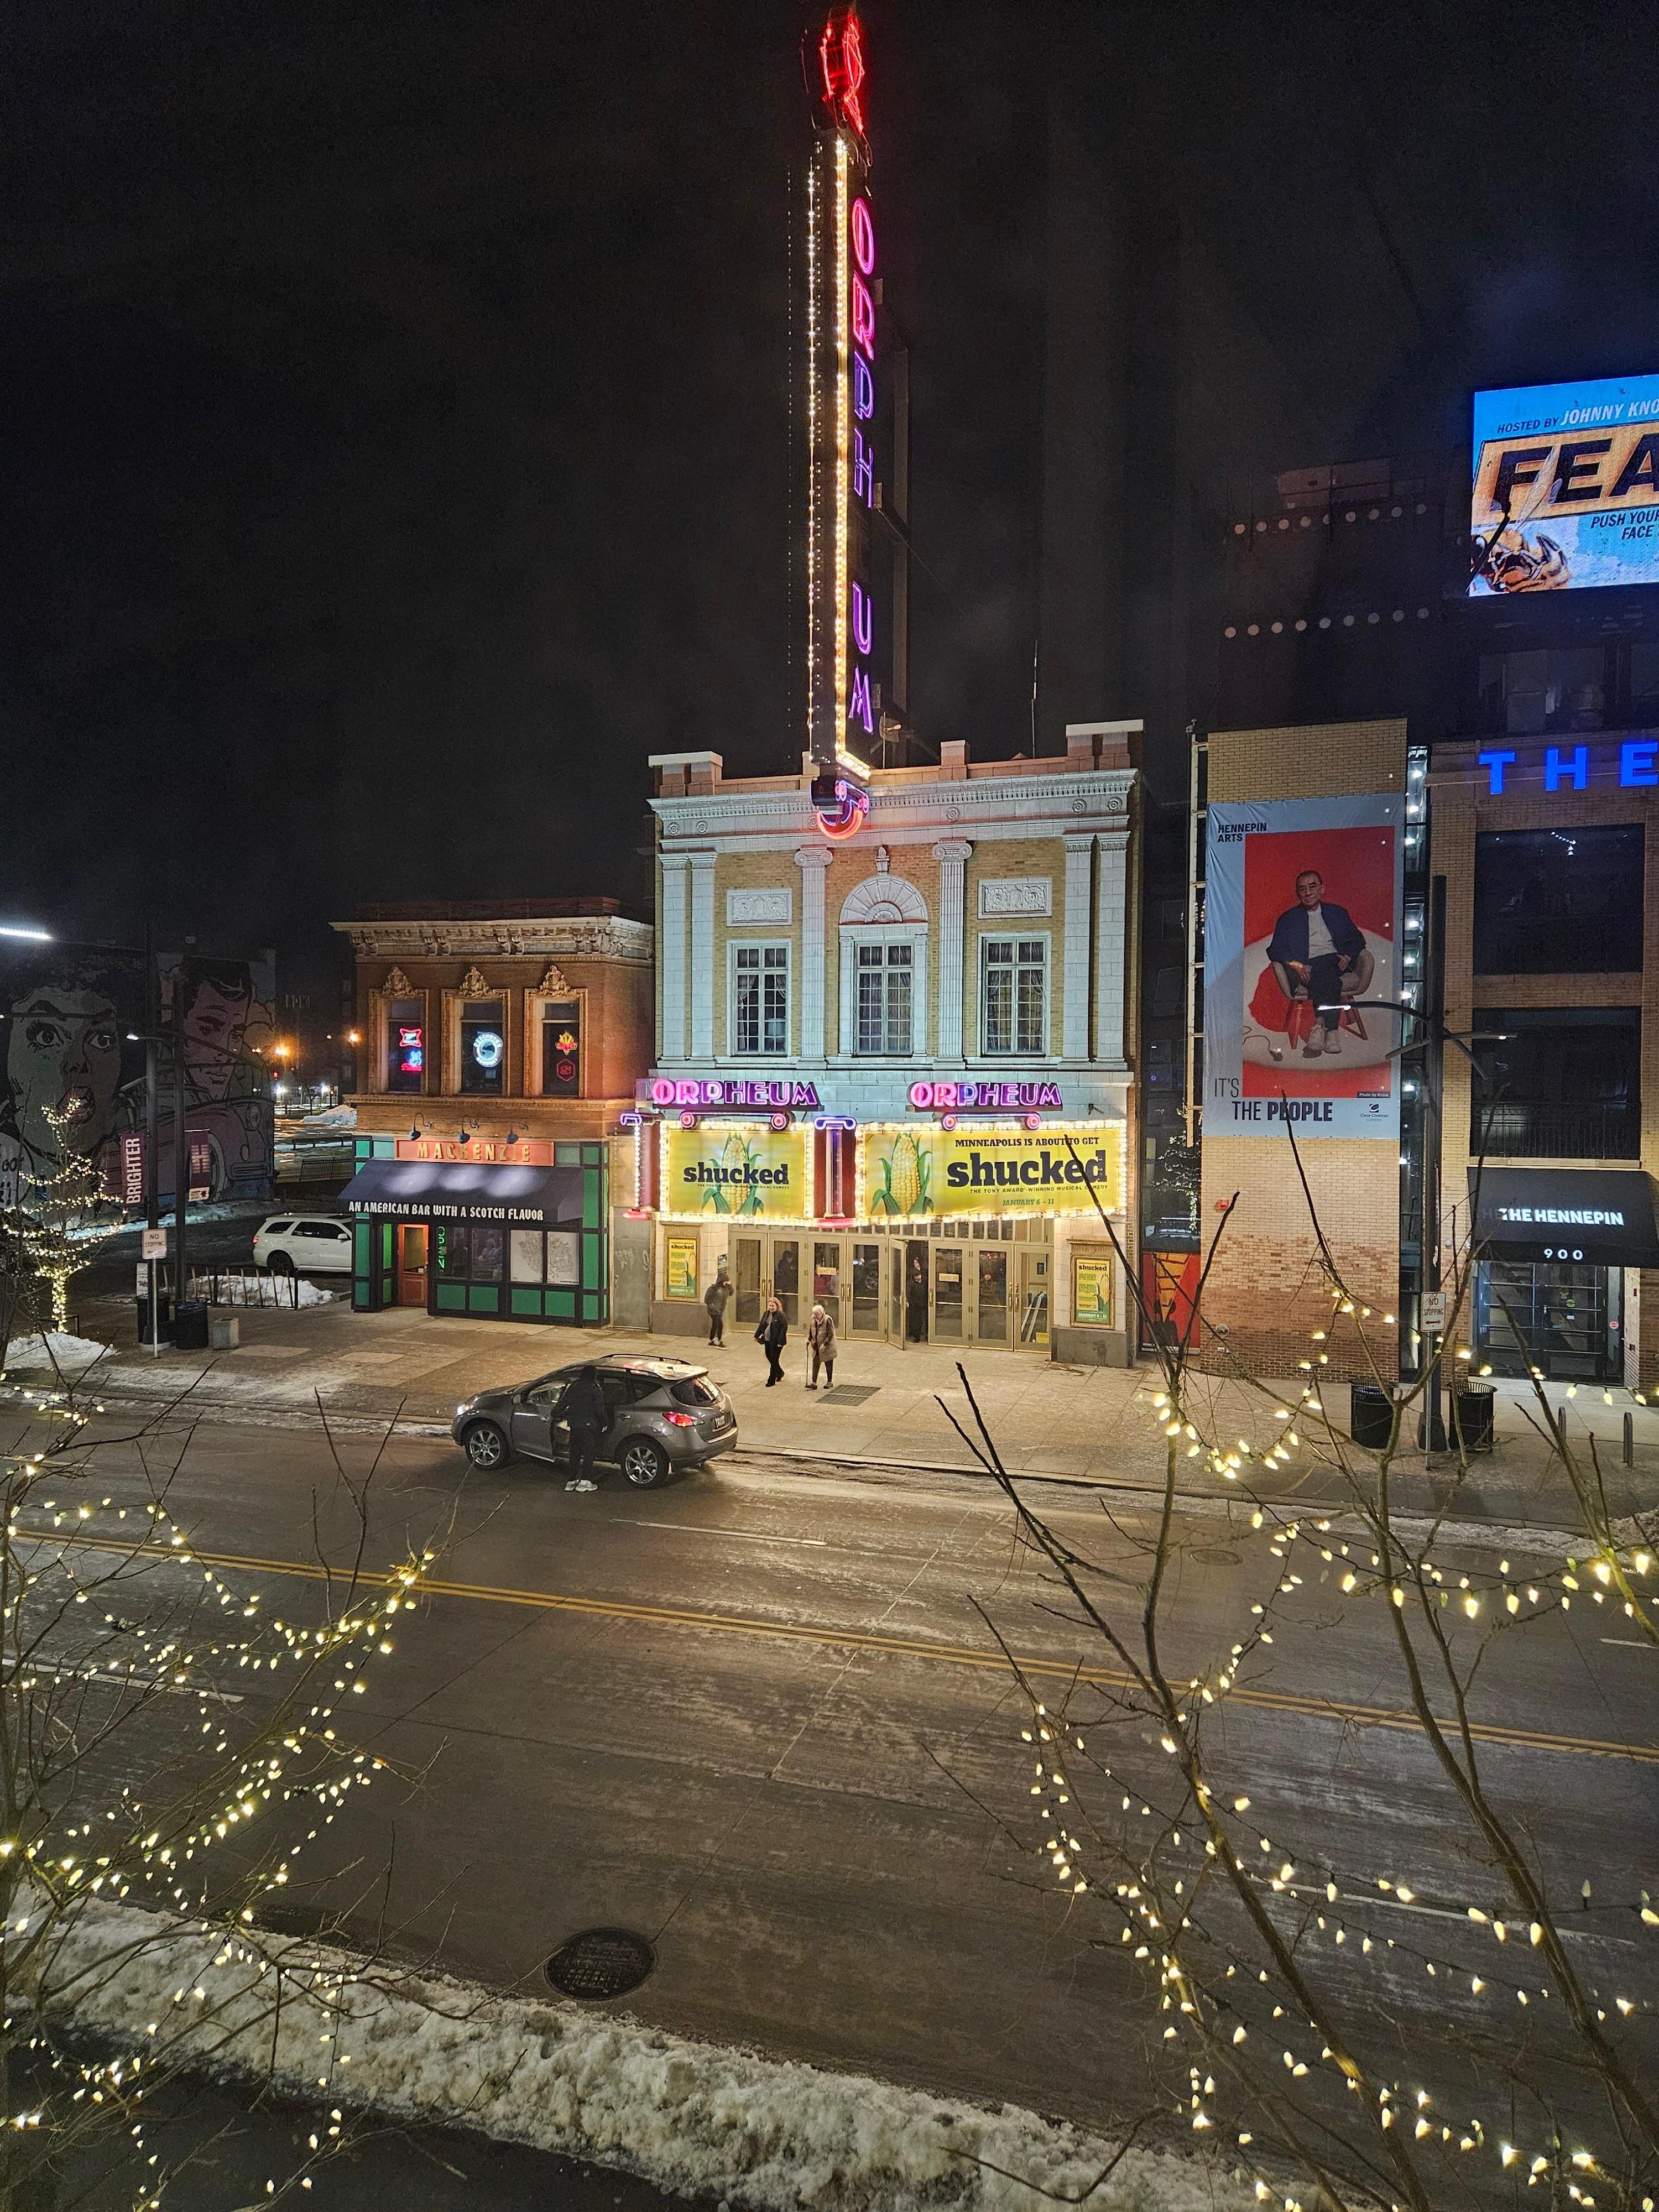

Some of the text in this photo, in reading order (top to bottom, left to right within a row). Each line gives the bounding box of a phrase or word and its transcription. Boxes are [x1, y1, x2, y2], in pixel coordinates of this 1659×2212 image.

[1497, 420, 1540, 434] HOSTED
[1544, 417, 1559, 428] BY
[1560, 404, 1624, 426] JOHNNY
[850, 199, 877, 735] ORPHUM
[1591, 513, 1626, 529] PUSH
[1621, 525, 1655, 540] FACE
[1479, 742, 1658, 795] THE
[1218, 822, 1267, 833] HENNEPIN
[1217, 833, 1243, 843] ARTS
[652, 1079, 818, 1106] ORPHEUM
[909, 1081, 1062, 1107] ORPHEUM
[1215, 1078, 1239, 1098] IT'S
[1232, 1101, 1333, 1121] THE PEOPLE
[417, 1141, 530, 1162] MACKENZIE
[955, 1138, 1022, 1147] MINNEAPOLIS
[1036, 1138, 1066, 1146] ABOUT
[125, 1138, 142, 1204] BRIGHTER
[684, 1162, 789, 1185] shucked
[947, 1150, 1108, 1188] shucked
[348, 1201, 361, 1212] AN
[363, 1202, 409, 1214] AMERICAN
[411, 1203, 430, 1215] BAR
[432, 1204, 458, 1217] WITH
[460, 1206, 467, 1217] A
[469, 1207, 505, 1219] SCOTCH
[1498, 1208, 1624, 1226] THE HENNEPIN
[1544, 1248, 1583, 1260] 900
